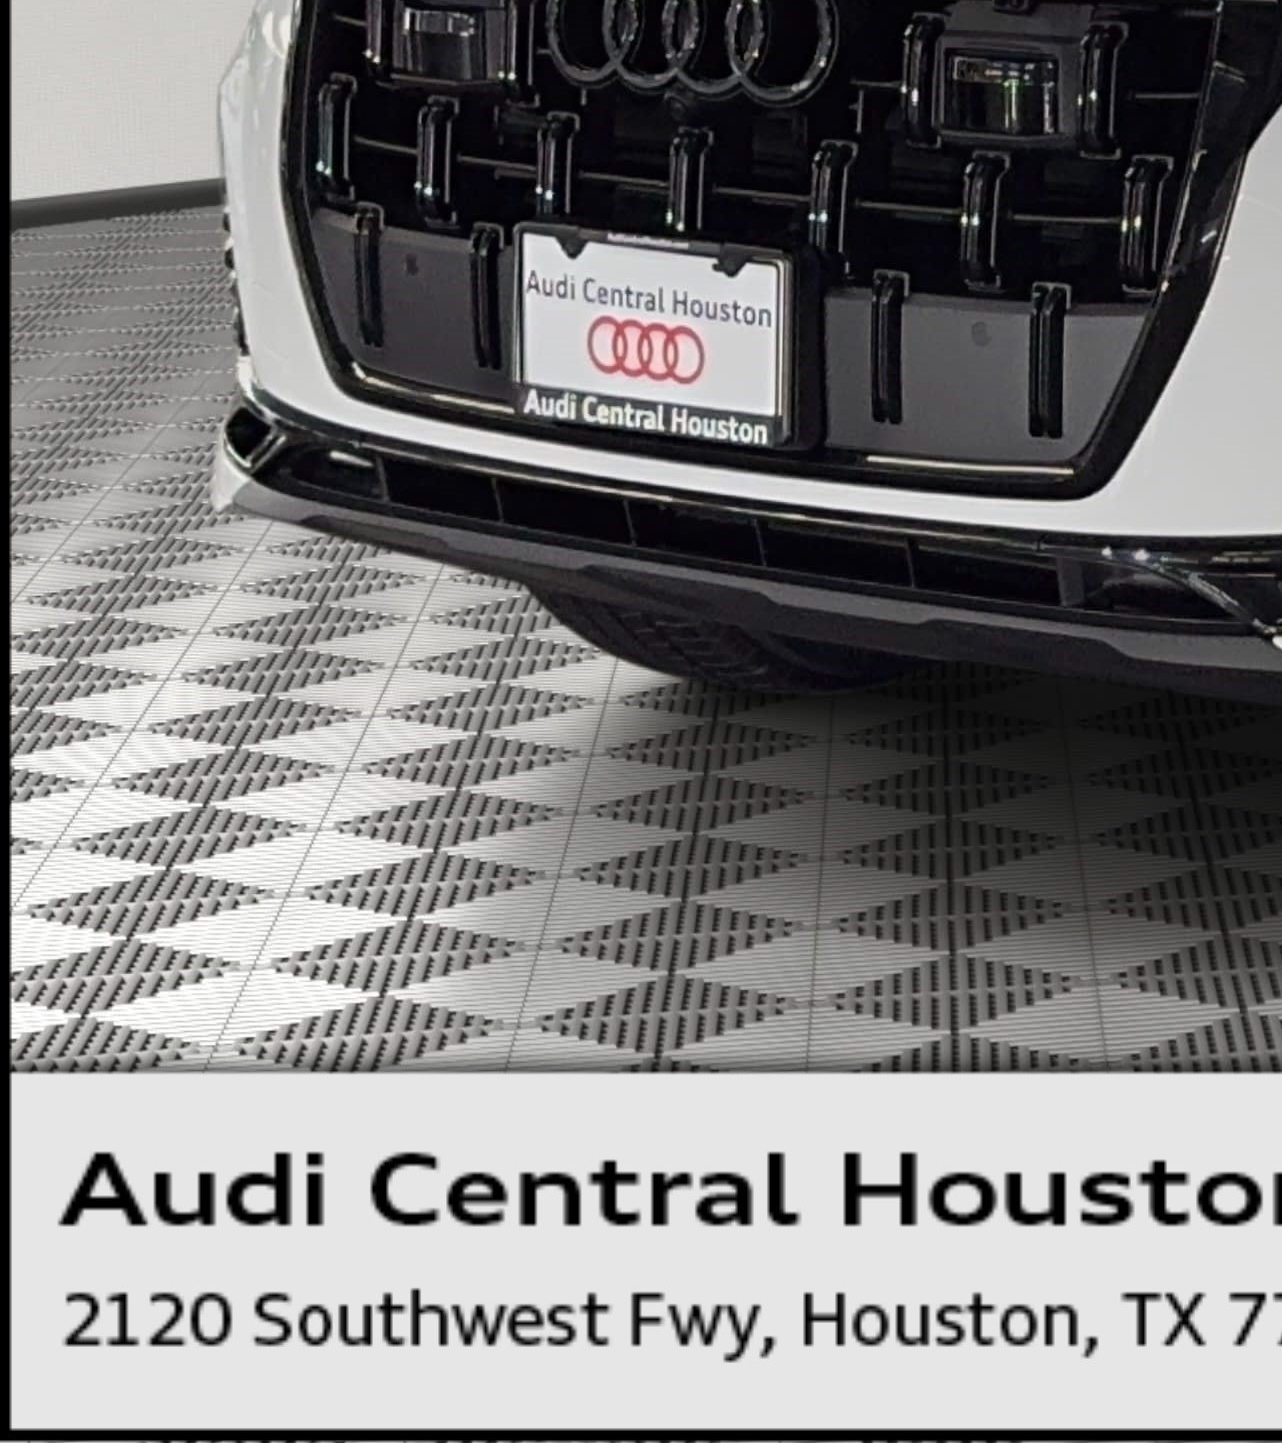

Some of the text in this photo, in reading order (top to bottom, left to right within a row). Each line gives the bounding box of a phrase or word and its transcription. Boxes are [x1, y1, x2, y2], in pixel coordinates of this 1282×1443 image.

[526, 269, 772, 327] Audi Central Houston
[523, 388, 768, 445] Audi Central Houston
